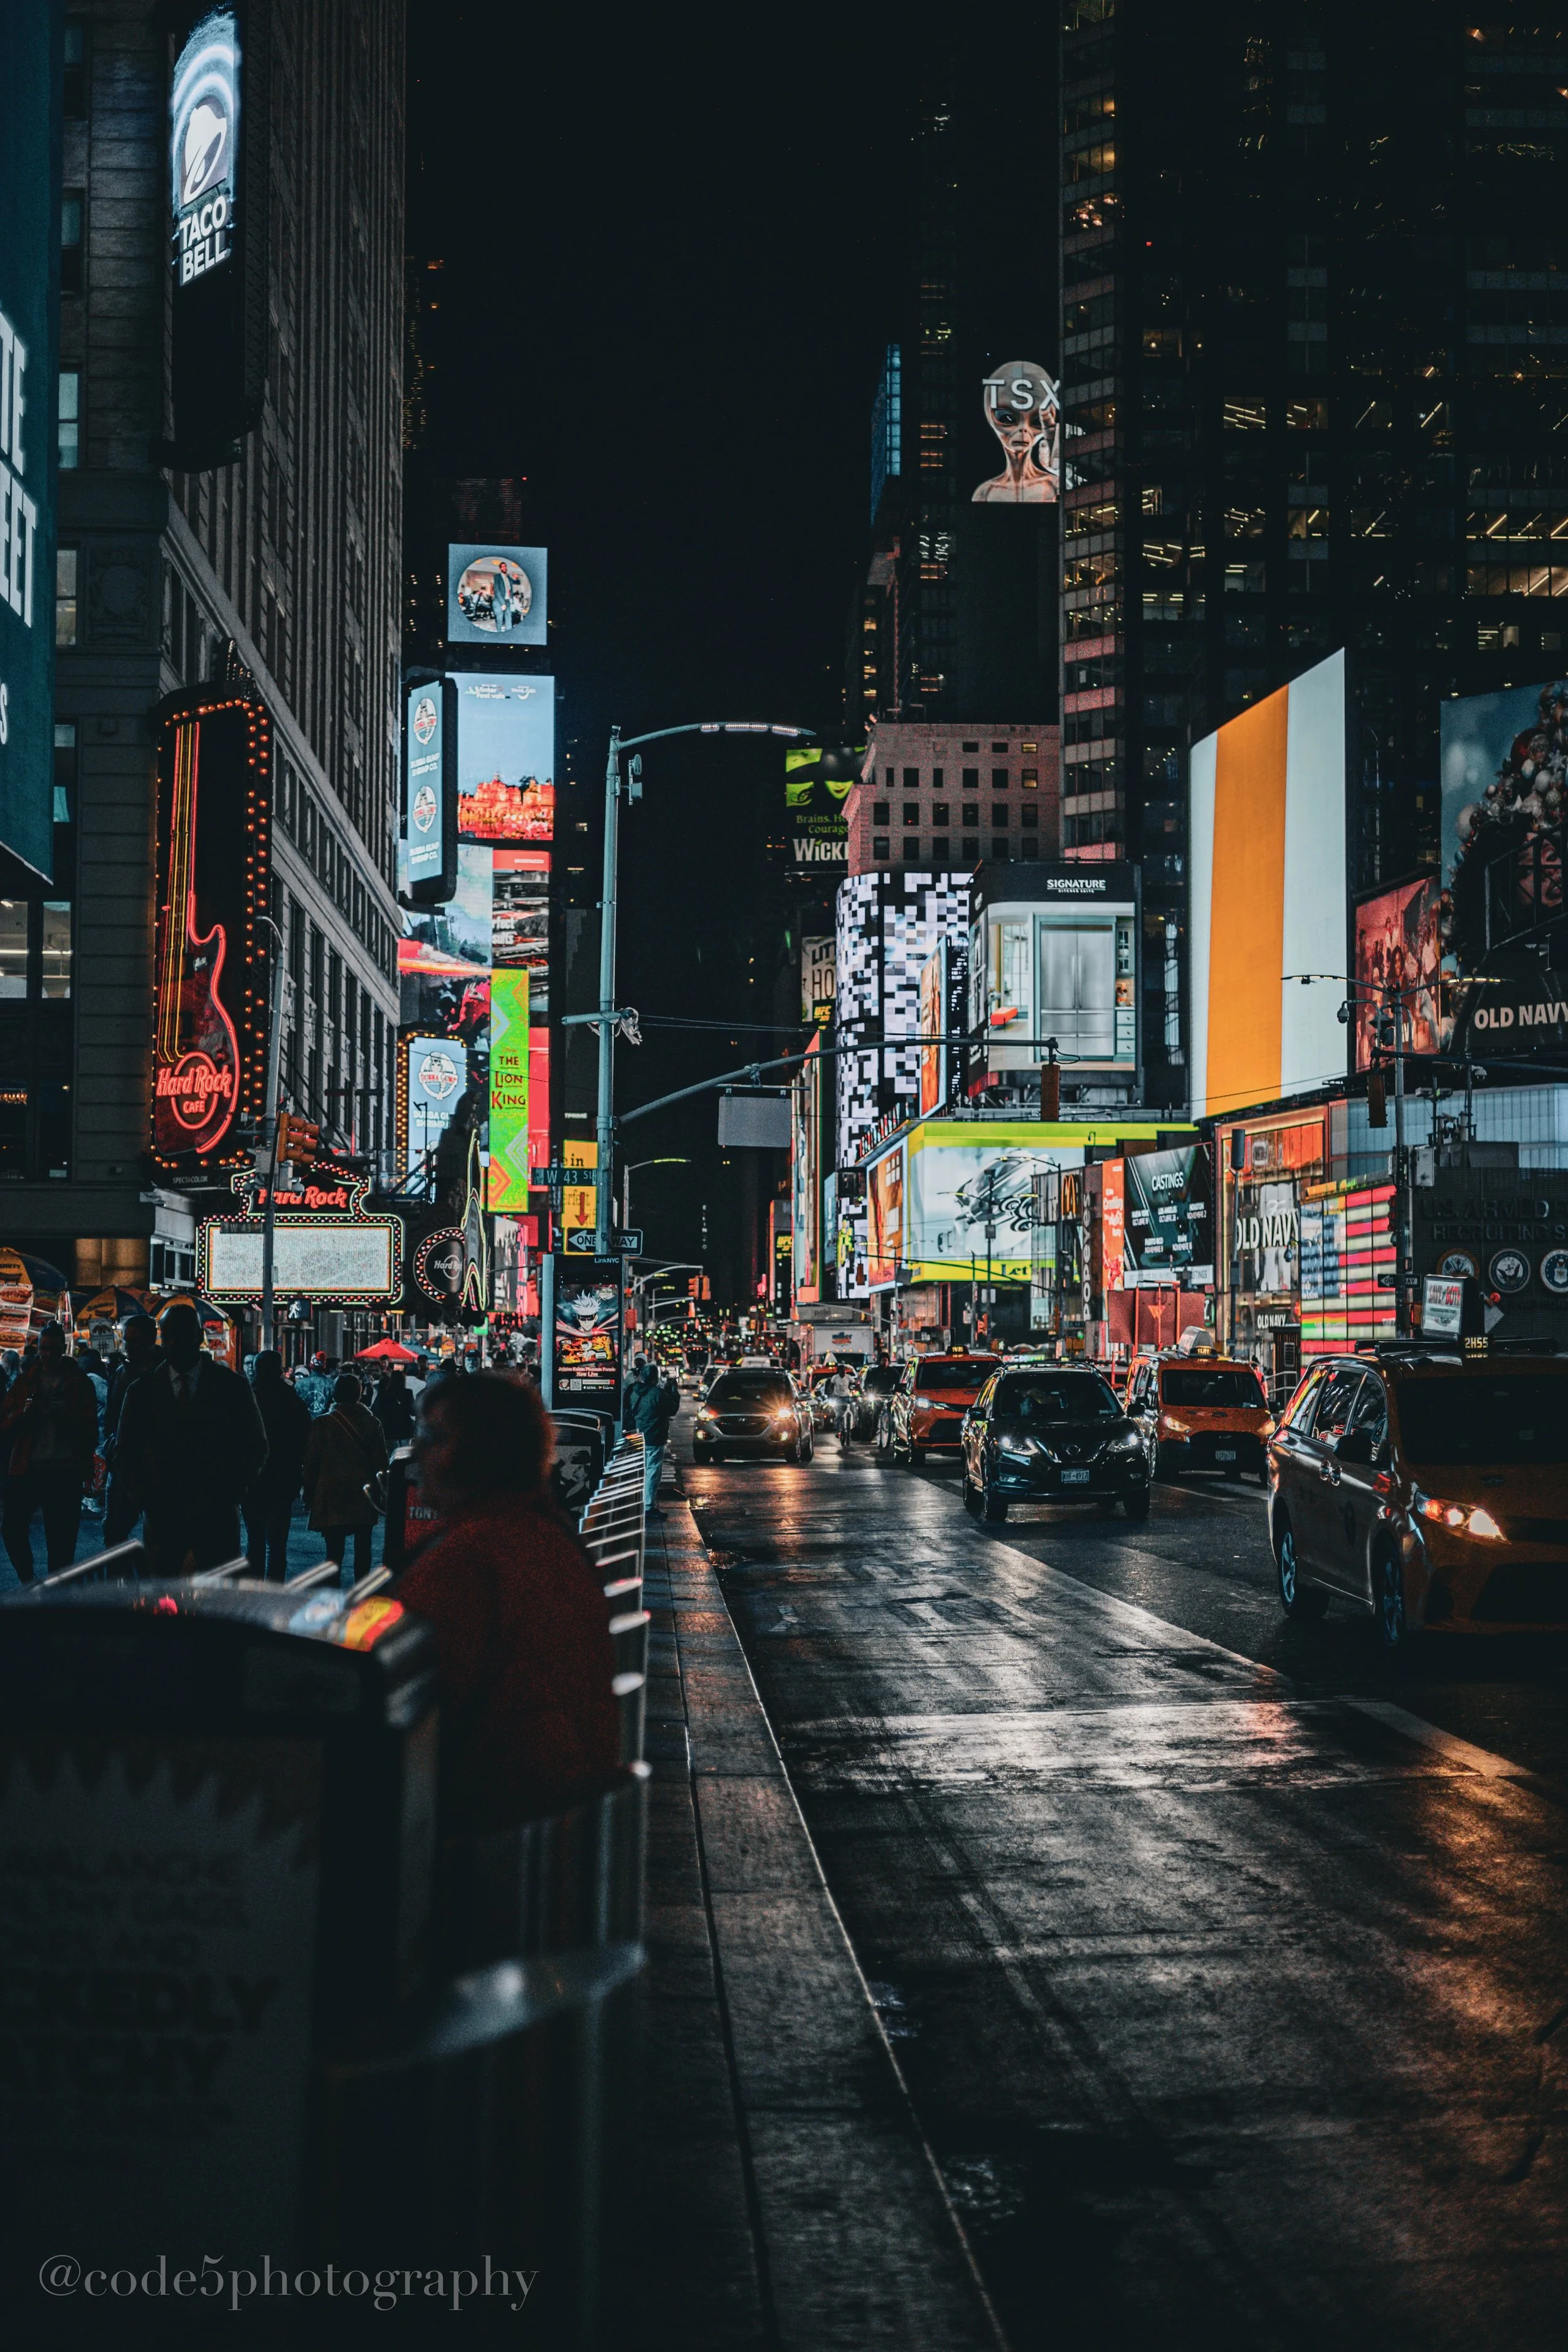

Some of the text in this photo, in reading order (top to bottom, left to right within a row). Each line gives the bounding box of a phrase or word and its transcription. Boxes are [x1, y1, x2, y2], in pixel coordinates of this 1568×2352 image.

[179, 196, 226, 250] TACO
[183, 230, 228, 283] BELL
[982, 378, 1061, 410] TSX
[796, 813, 832, 824] Brains.
[1047, 879, 1106, 889] SIGNATURE
[814, 1005, 832, 1015] UFC
[1475, 1009, 1514, 1029] OLD
[499, 1056, 519, 1066] THE
[156, 1064, 232, 1099] Hard Rock
[183, 1100, 206, 1114] CAFE
[492, 1091, 526, 1110] KING
[413, 1110, 439, 1120] BUBBA
[416, 1120, 445, 1128] SHRIMP
[172, 1175, 208, 1184] SPECTACOLOR
[547, 1170, 557, 1184] W
[564, 1170, 577, 1184] 43
[1152, 1171, 1184, 1192] CASTINGS
[304, 1186, 347, 1208] Rock
[613, 1236, 635, 1246] WAY
[1257, 1314, 1286, 1329] OLD NAVY
[1465, 1337, 1488, 1348] 2H55
